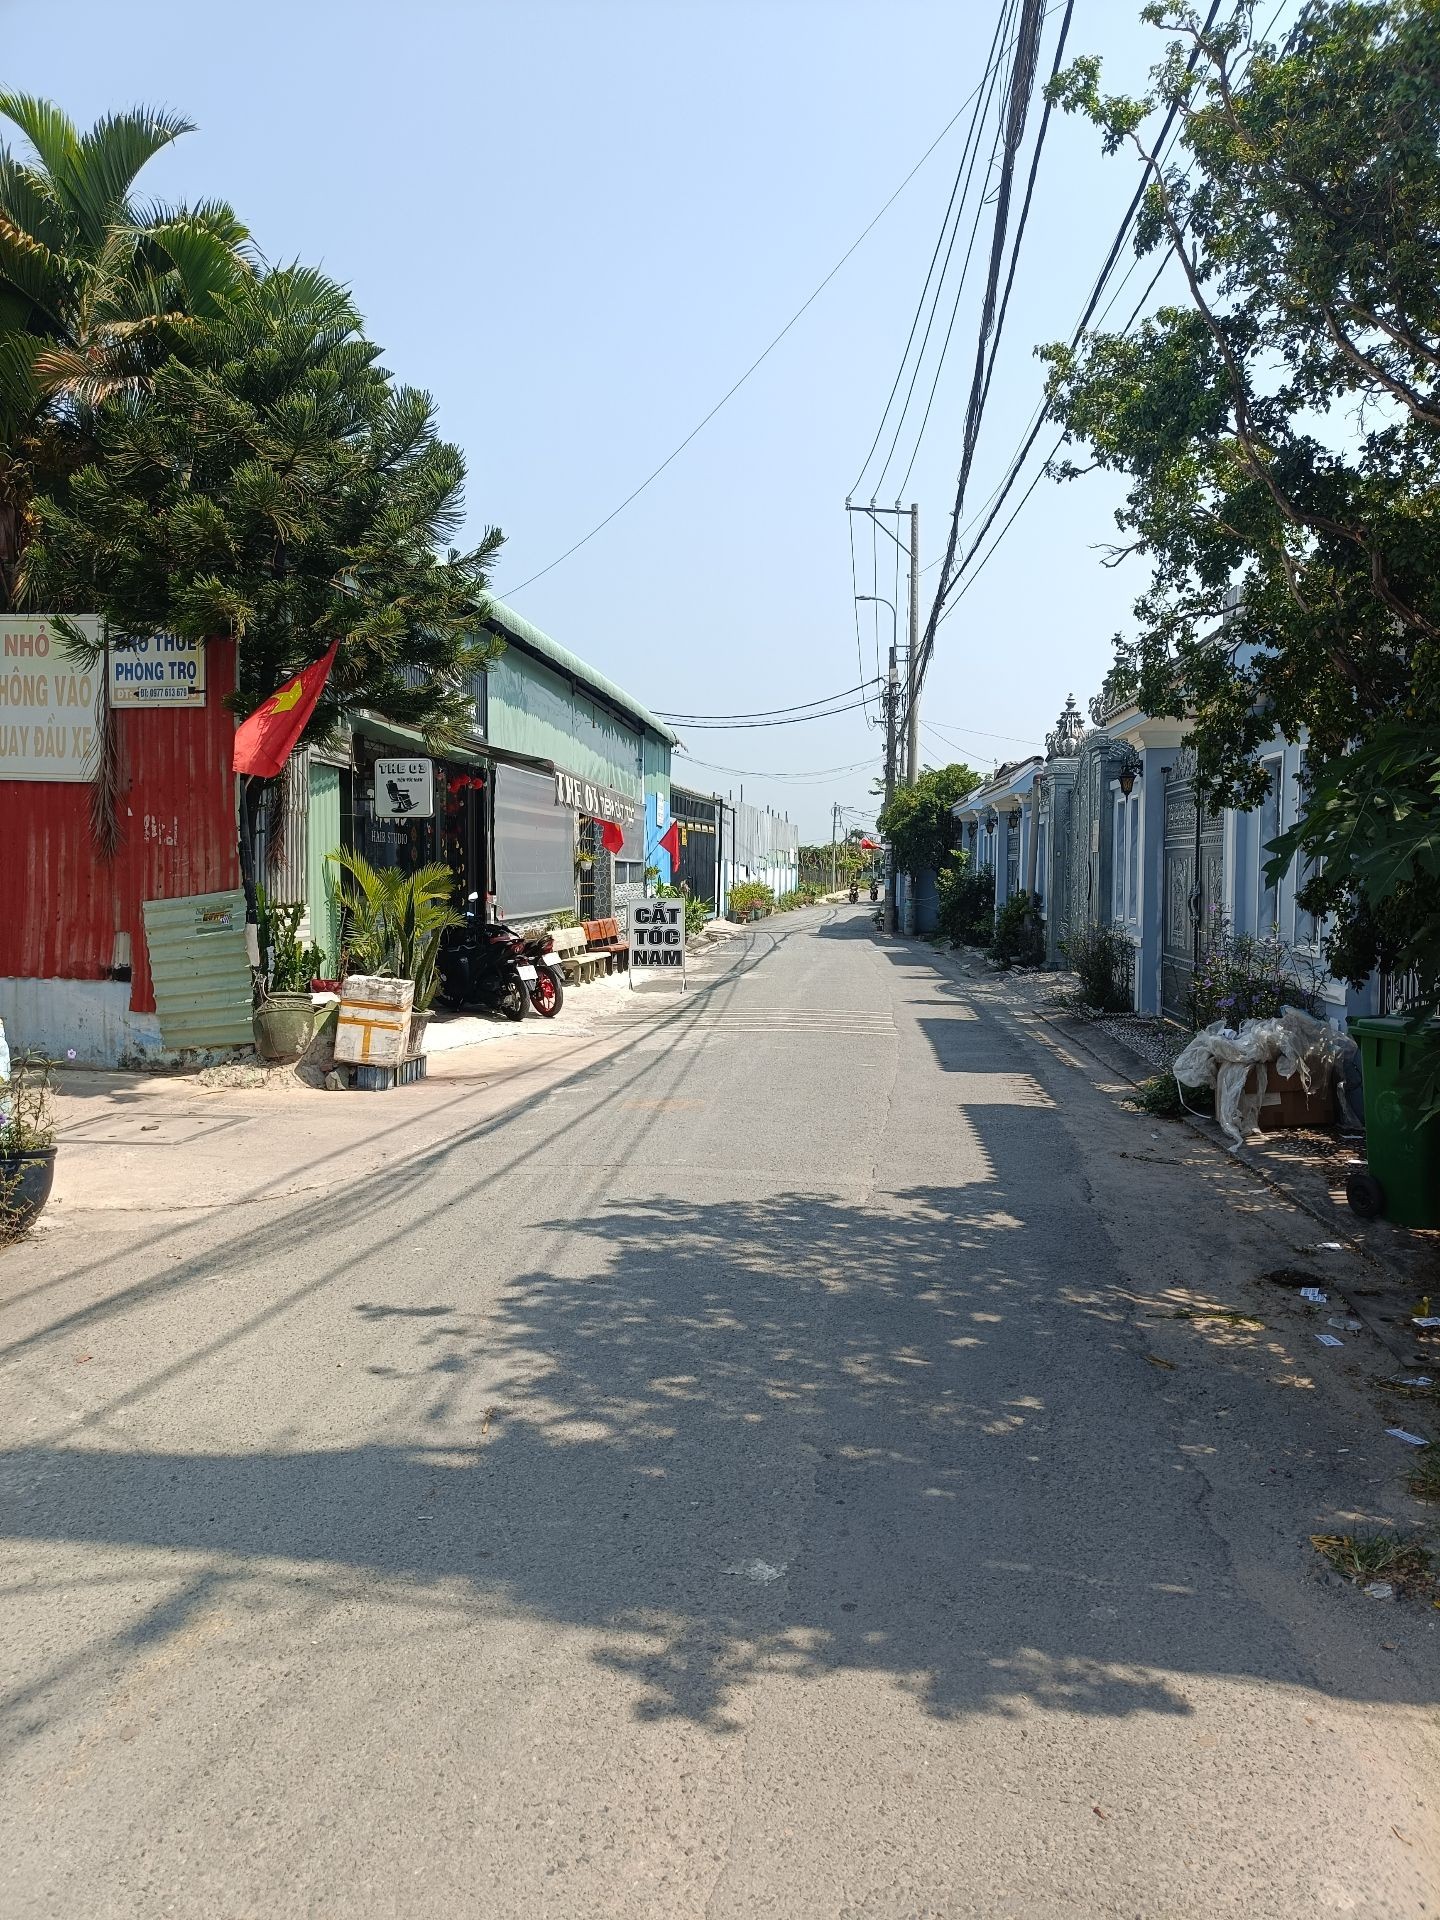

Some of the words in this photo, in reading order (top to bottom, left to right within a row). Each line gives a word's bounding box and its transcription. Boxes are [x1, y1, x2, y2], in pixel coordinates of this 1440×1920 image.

[4, 624, 50, 658] NHỎ
[168, 660, 197, 685] TRỌ
[54, 667, 93, 708] VÀO
[34, 713, 66, 758] ĐẦU
[72, 726, 92, 759] XE
[556, 771, 583, 809] THE
[585, 784, 599, 814] 03
[371, 830, 386, 843] HAIR
[387, 832, 408, 845] STUDIO
[634, 901, 682, 925] CẮT
[632, 949, 683, 967] NAM
